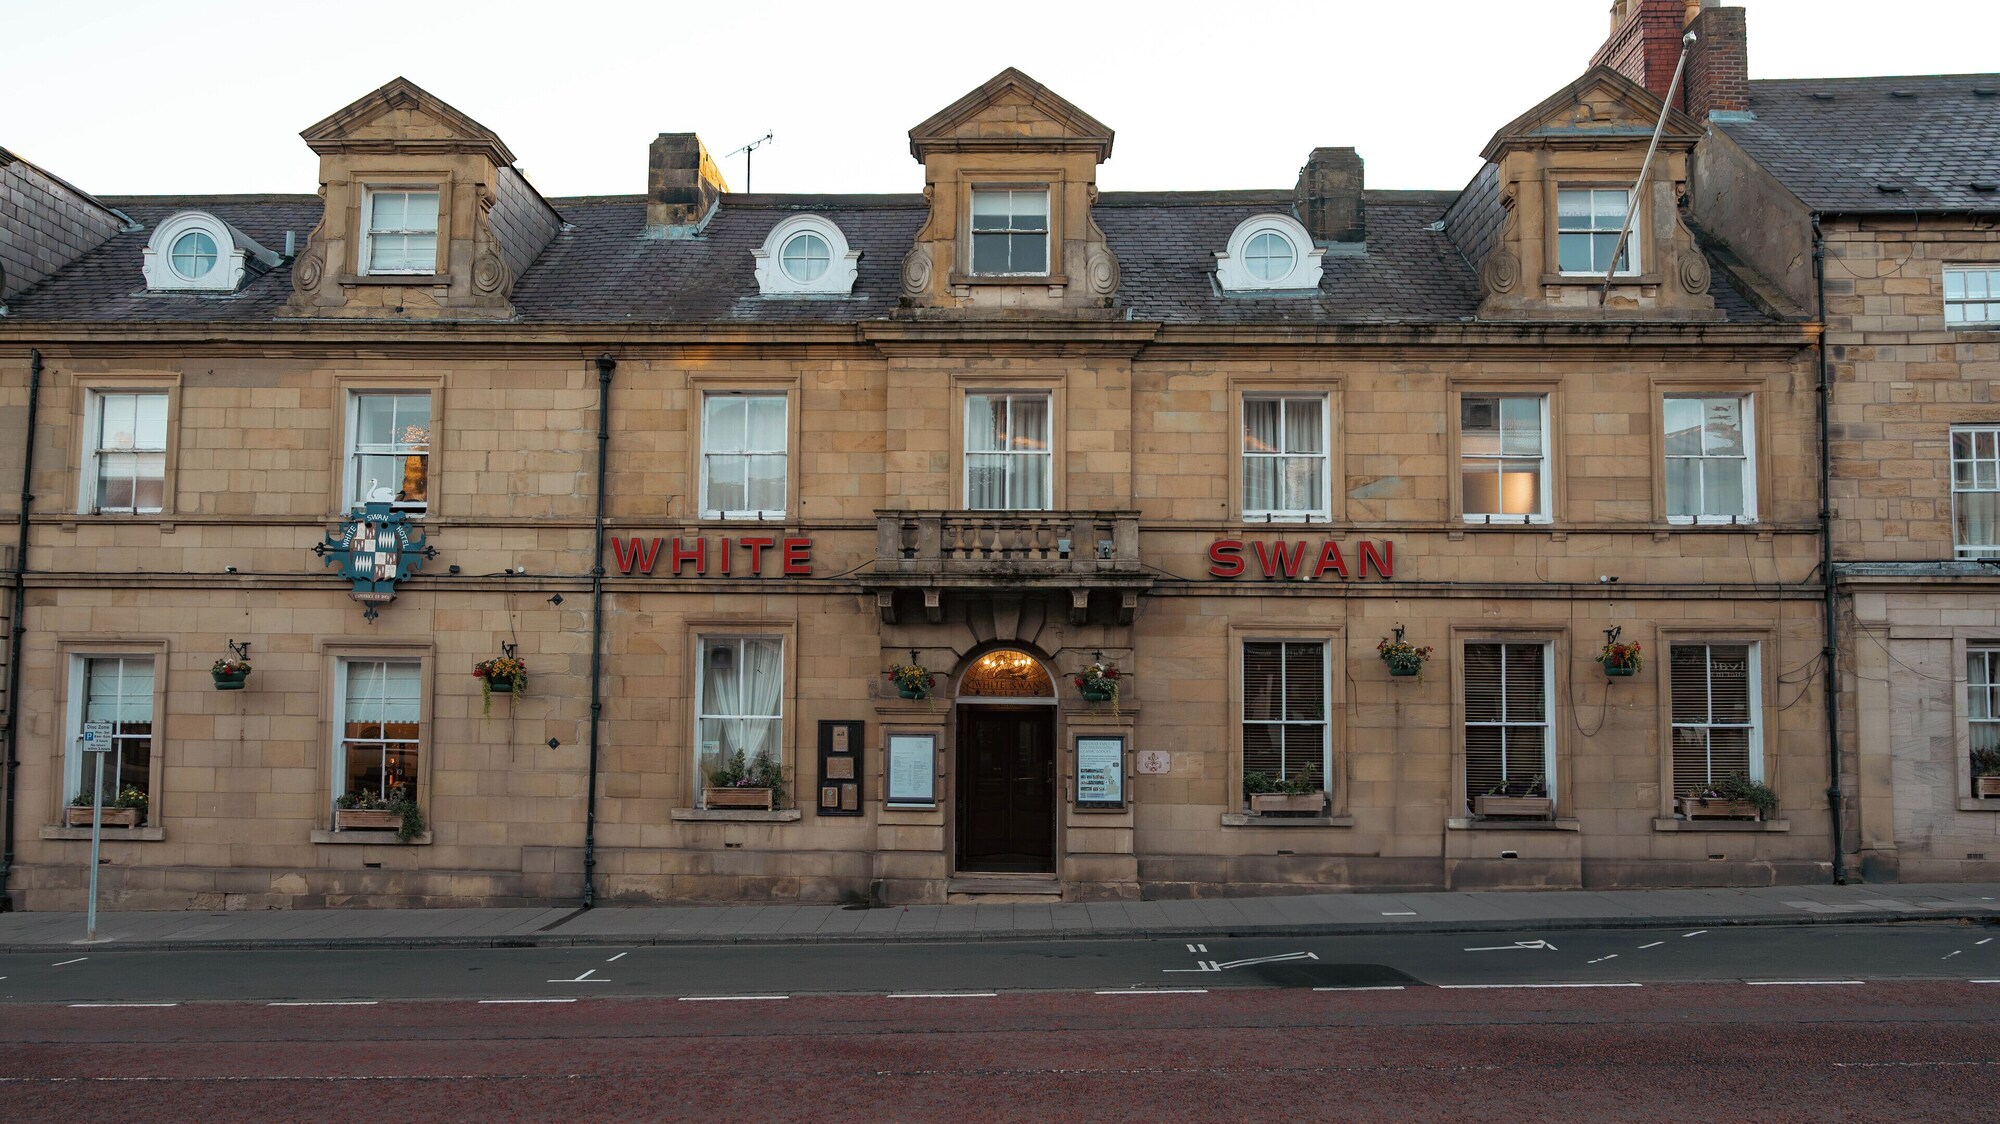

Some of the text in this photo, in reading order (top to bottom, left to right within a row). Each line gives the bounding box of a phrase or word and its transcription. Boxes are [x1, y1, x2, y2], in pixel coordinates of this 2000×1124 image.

[342, 513, 410, 549] WHITE SWAN HOTEL
[610, 537, 1393, 578] WHITE SWAN
[974, 681, 1040, 689] WHITE SWAN
